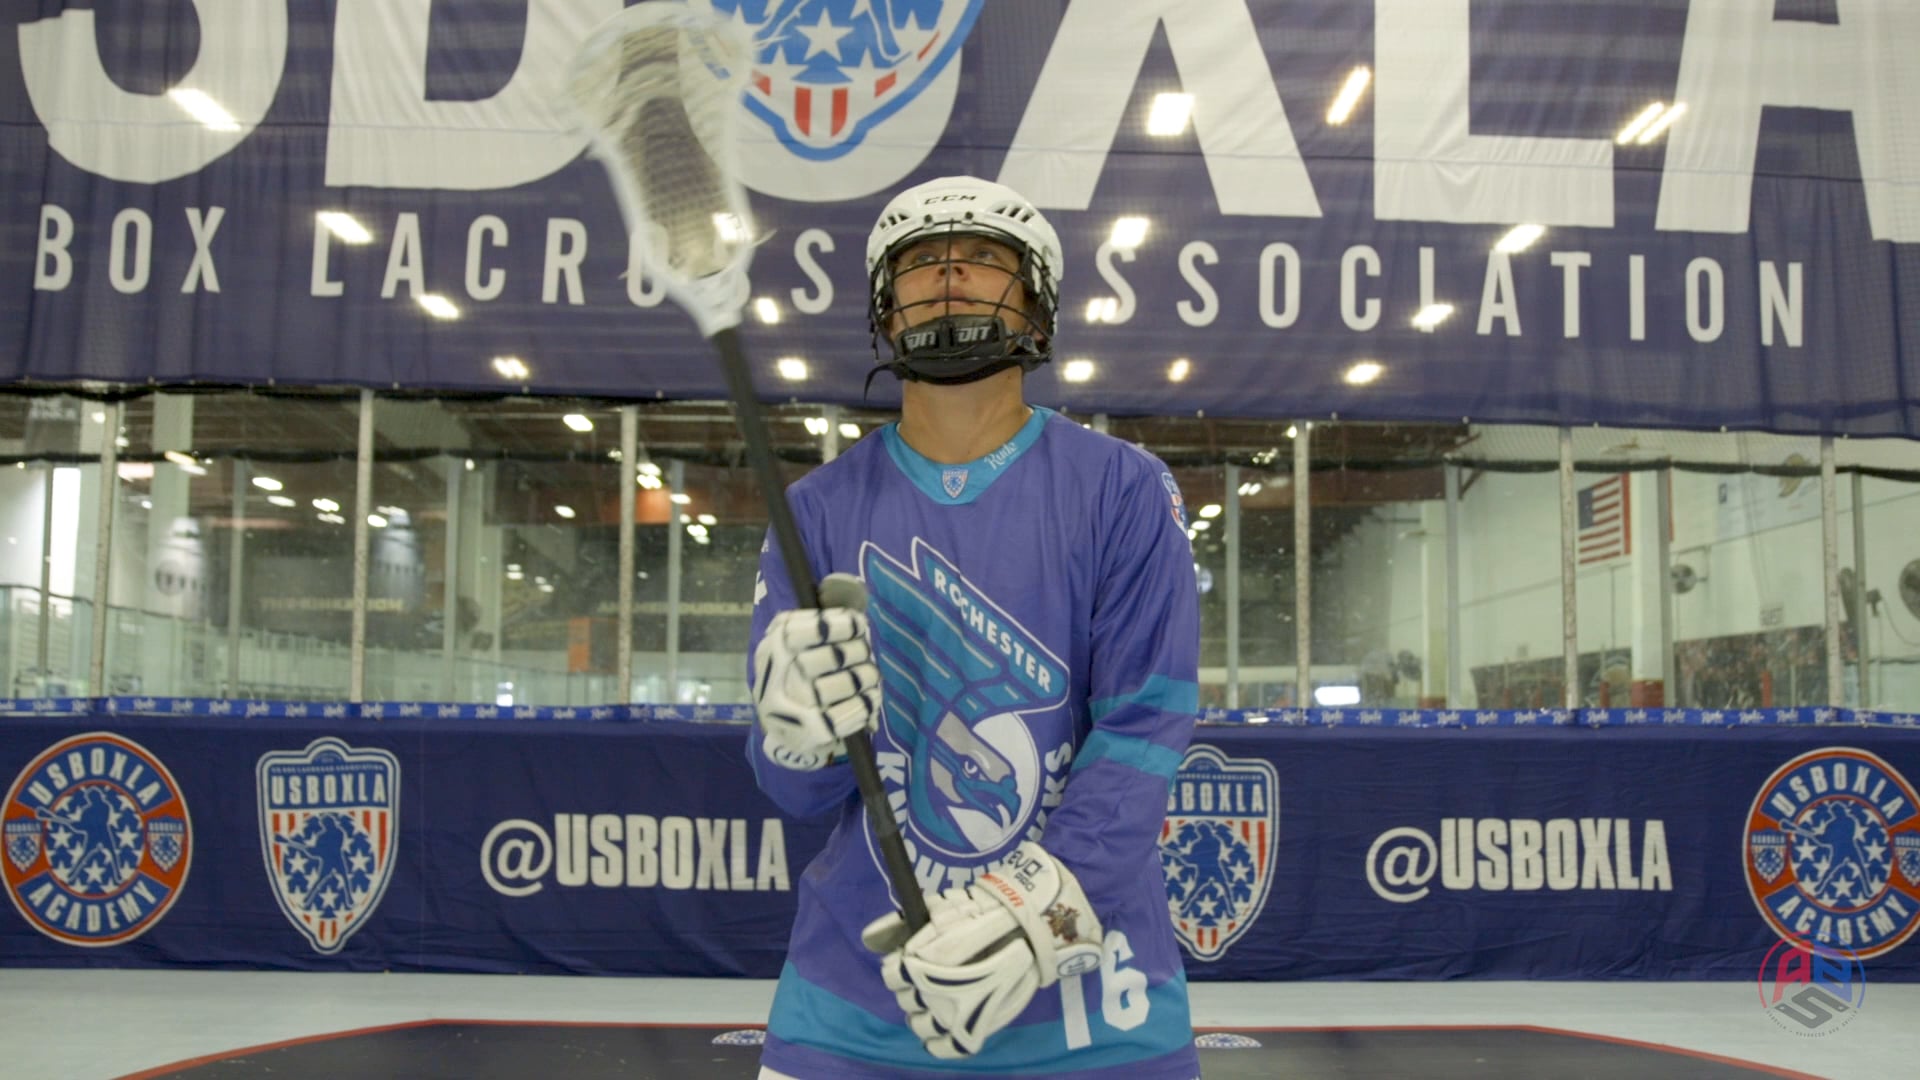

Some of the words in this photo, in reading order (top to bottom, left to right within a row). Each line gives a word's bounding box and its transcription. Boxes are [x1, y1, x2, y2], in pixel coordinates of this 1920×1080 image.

[924, 194, 977, 205] CCM
[34, 204, 226, 293] BOX
[310, 212, 837, 314] LACROS
[1095, 241, 1802, 348] SSOCIATION
[933, 567, 1052, 693] ROCHESTER
[28, 747, 162, 805] USBOXLA
[271, 773, 387, 805] USBOXLA
[1167, 782, 1265, 812] BOXLA
[1771, 763, 1905, 819] USBOXLA
[480, 813, 791, 897] @USBOXLA
[1366, 818, 1673, 902] @USBOXLA
[28, 880, 157, 933] ACADEMY
[1777, 894, 1909, 946] ACADEMY
